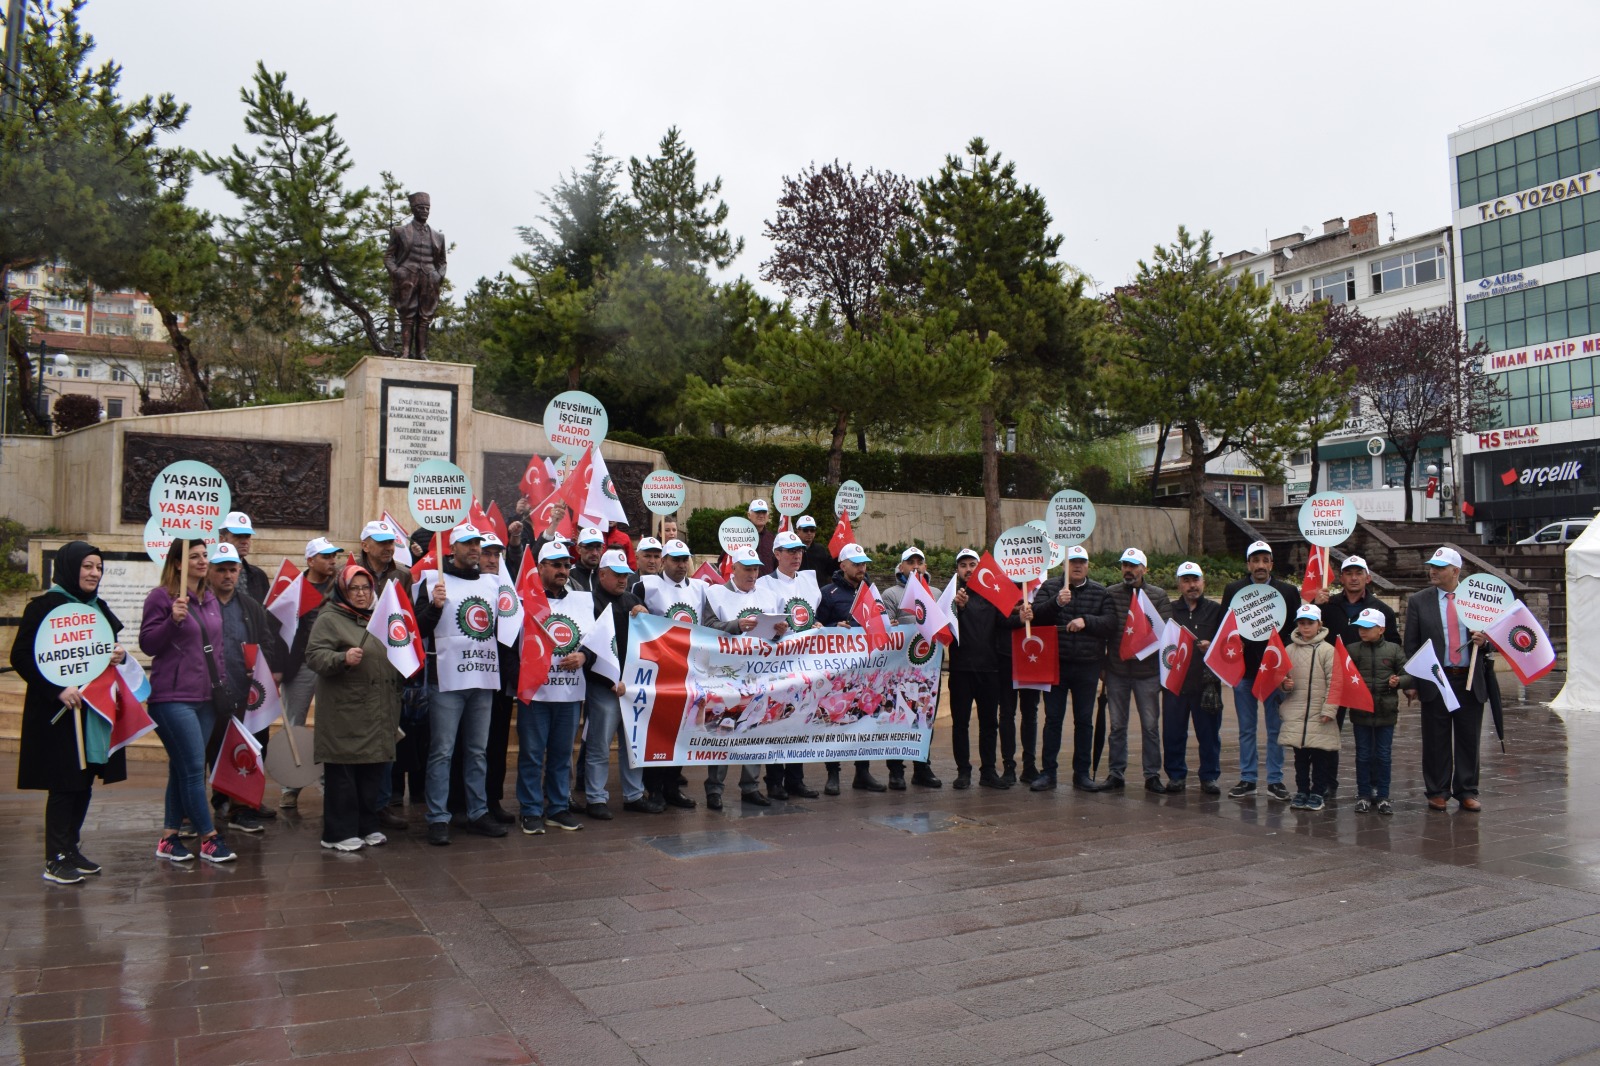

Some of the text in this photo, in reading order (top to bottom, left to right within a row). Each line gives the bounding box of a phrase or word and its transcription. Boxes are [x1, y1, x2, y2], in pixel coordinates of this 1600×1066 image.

[1478, 174, 1592, 221] T.C. YOZGAT
[1494, 272, 1524, 286] Atlas
[1491, 352, 1527, 369] İMAM
[1534, 341, 1576, 362] HATİP
[553, 400, 602, 417] MEVSİMLİK
[559, 410, 593, 426] İŞÇİLER
[558, 423, 590, 437] KADRO
[551, 434, 594, 448] BEKLİYOR
[1478, 426, 1539, 449] HS EMLAK
[162, 473, 222, 488] YAŞASIN
[413, 473, 465, 483] DİYARBAKIR
[1519, 460, 1582, 487] arçelik
[164, 489, 219, 503] 1 MAYIS
[413, 484, 466, 495] ANNELERİNE
[650, 491, 676, 499] SENDİKAL
[417, 498, 462, 511] SELAM
[647, 500, 679, 508] DAYANIŞMA
[1311, 496, 1345, 507] ASGARİ
[159, 502, 220, 516] YAŞASIN
[1313, 508, 1342, 518] ÜCRET
[424, 515, 455, 524] OLSUN
[1058, 518, 1082, 526] İŞÇİLER
[1312, 519, 1344, 527] YENİDEN
[721, 526, 755, 534] YOKSULLUĞA
[1054, 532, 1086, 540] BEKLİYOR
[1304, 527, 1350, 537] BELİRLENSİN
[1001, 535, 1043, 547] YAŞASIN
[1011, 546, 1042, 556] MAYIS
[1001, 556, 1044, 567] YAŞASIN
[1468, 578, 1507, 594] SALGINI
[1241, 589, 1260, 602] TOPLU
[1468, 589, 1503, 605] YENDİK
[1234, 590, 1279, 616] ÖZLEŞMELERİMİZ
[1456, 599, 1500, 614] ENFLASYONU
[1240, 602, 1276, 623] ENFLASYONA
[49, 612, 96, 629] TERÖRE
[1250, 613, 1274, 629] KURBAN
[1251, 620, 1281, 638] EDİLMESN
[54, 629, 94, 645] LANET
[38, 641, 112, 664] KARDEŞLİĞE
[717, 636, 773, 658] HAK-İŞ
[462, 648, 496, 661] HAK-İŞ
[60, 662, 90, 676] EVET
[746, 653, 888, 674] YOZGAT İL BAŞKANLIĞI
[544, 675, 580, 686] ÖREVLİ
[689, 737, 701, 746] ELİ
[701, 737, 729, 747] ÖPÜLESİ
[729, 736, 764, 746] KAHRAMAN
[811, 733, 825, 743] YENİ
[825, 733, 835, 742] BİR
[836, 733, 856, 742] DÜNYA
[857, 733, 871, 743] İNŞA
[871, 733, 890, 742] ETMEK
[890, 732, 922, 742] HEDEFİMİZ
[687, 750, 692, 760] 1
[695, 750, 728, 760] MAYIS
[729, 752, 767, 760] Uluslararası
[786, 748, 816, 759] Mücadele
[825, 748, 857, 759] Dayanışma
[858, 747, 885, 756] Günümüz
[884, 746, 901, 755] Kutlu
[901, 746, 920, 756] Olsun
